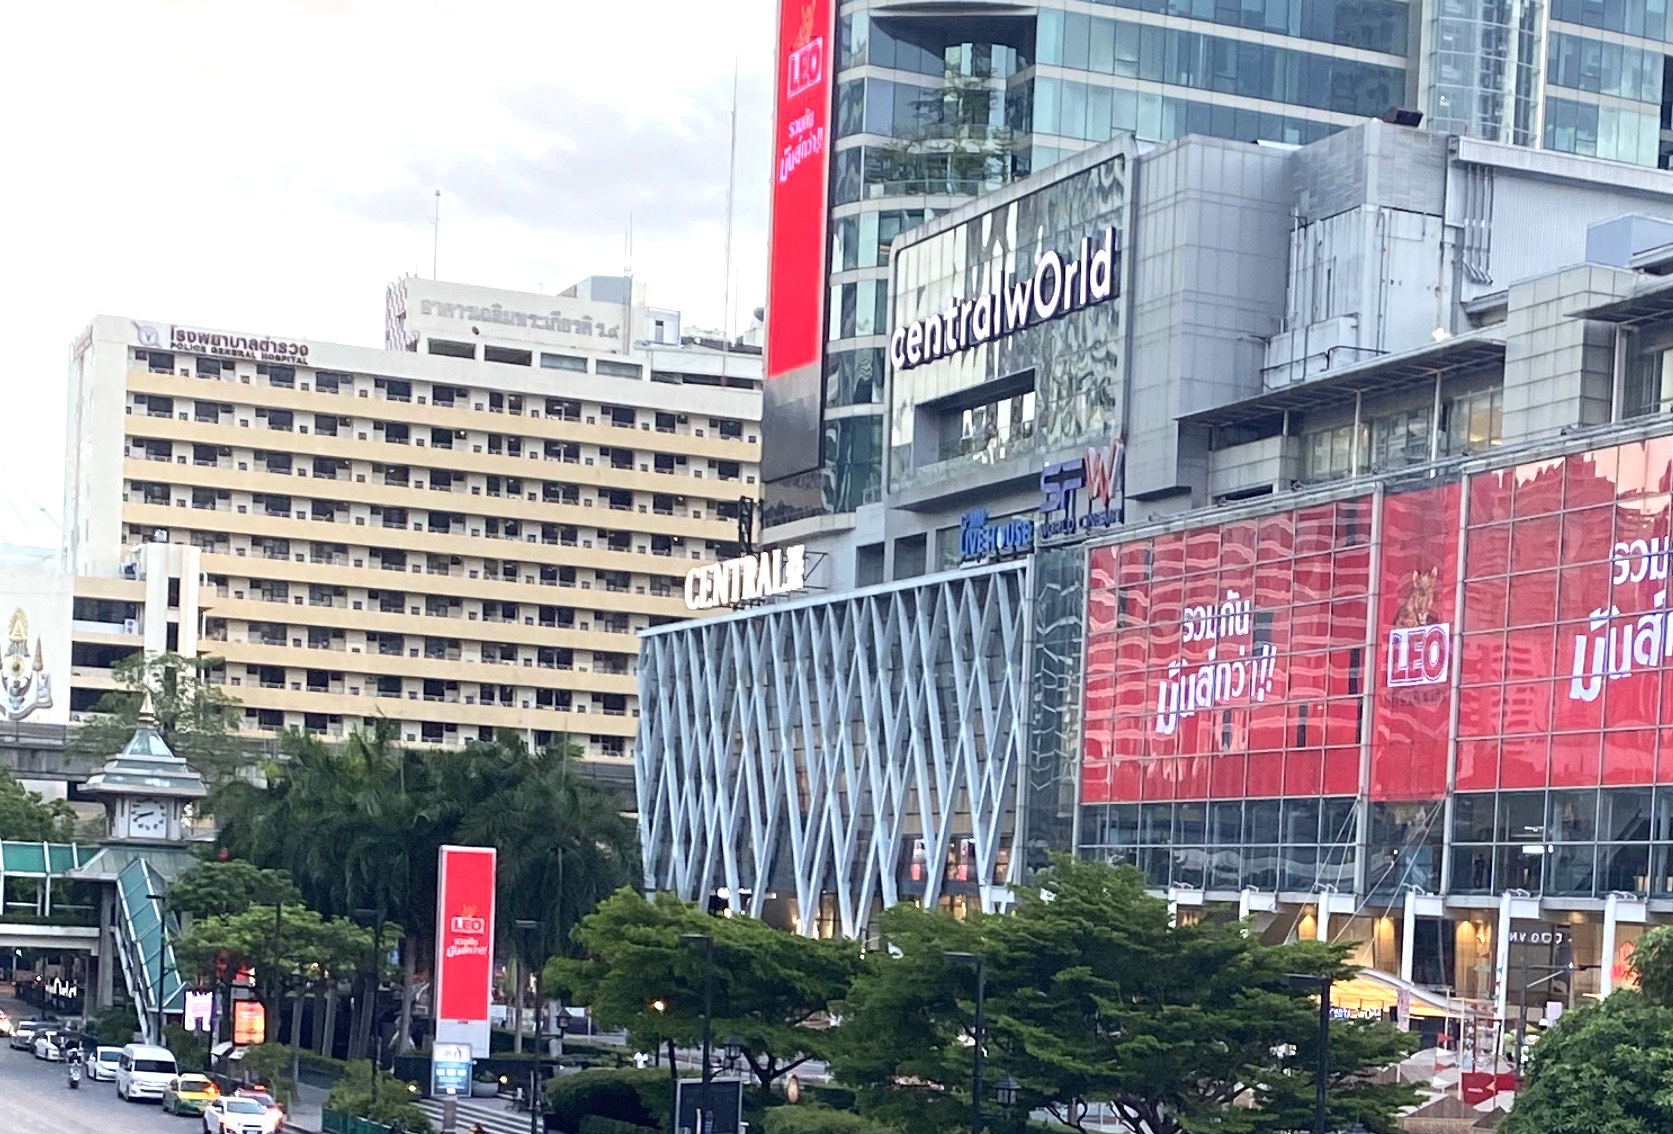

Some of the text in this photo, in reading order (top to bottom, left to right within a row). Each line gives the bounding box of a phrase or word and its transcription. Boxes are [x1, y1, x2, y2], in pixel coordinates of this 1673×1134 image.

[891, 226, 1116, 370] centralwOrld
[170, 324, 310, 357] โรงพยาบาลตำรวจ
[170, 342, 309, 366] POLICE GENERAL HOSPITAL
[685, 548, 788, 610] CENTRAL
[1182, 589, 1250, 643] รวมกัน
[1389, 626, 1448, 684] LEO
